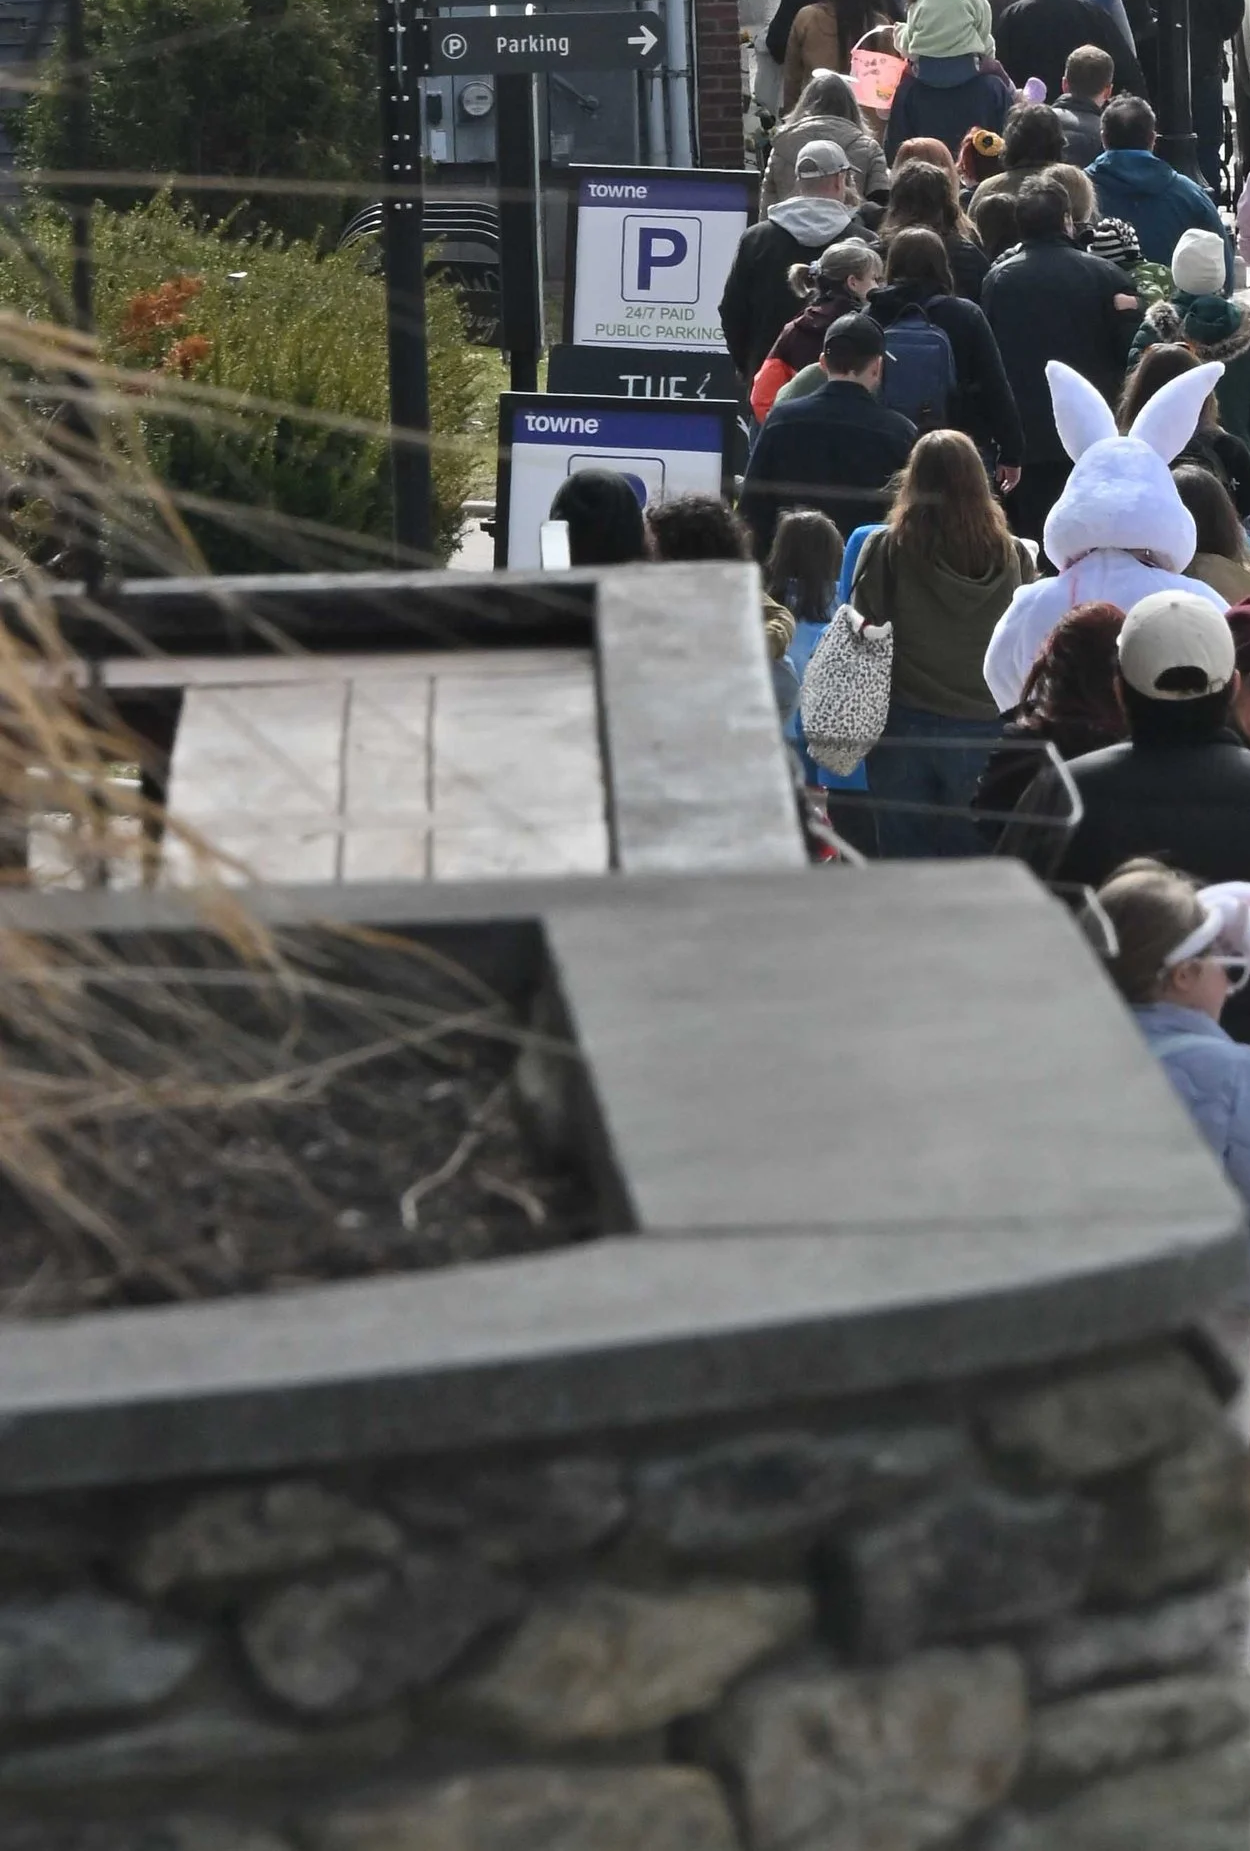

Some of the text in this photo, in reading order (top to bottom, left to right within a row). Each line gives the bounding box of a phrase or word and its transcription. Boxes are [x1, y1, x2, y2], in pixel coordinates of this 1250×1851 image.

[496, 34, 570, 56] Parking
[588, 183, 648, 198] towne
[625, 306, 695, 321] 24/7 PAID
[595, 323, 726, 341] PUBLIC PARKING
[525, 414, 600, 435] towne
